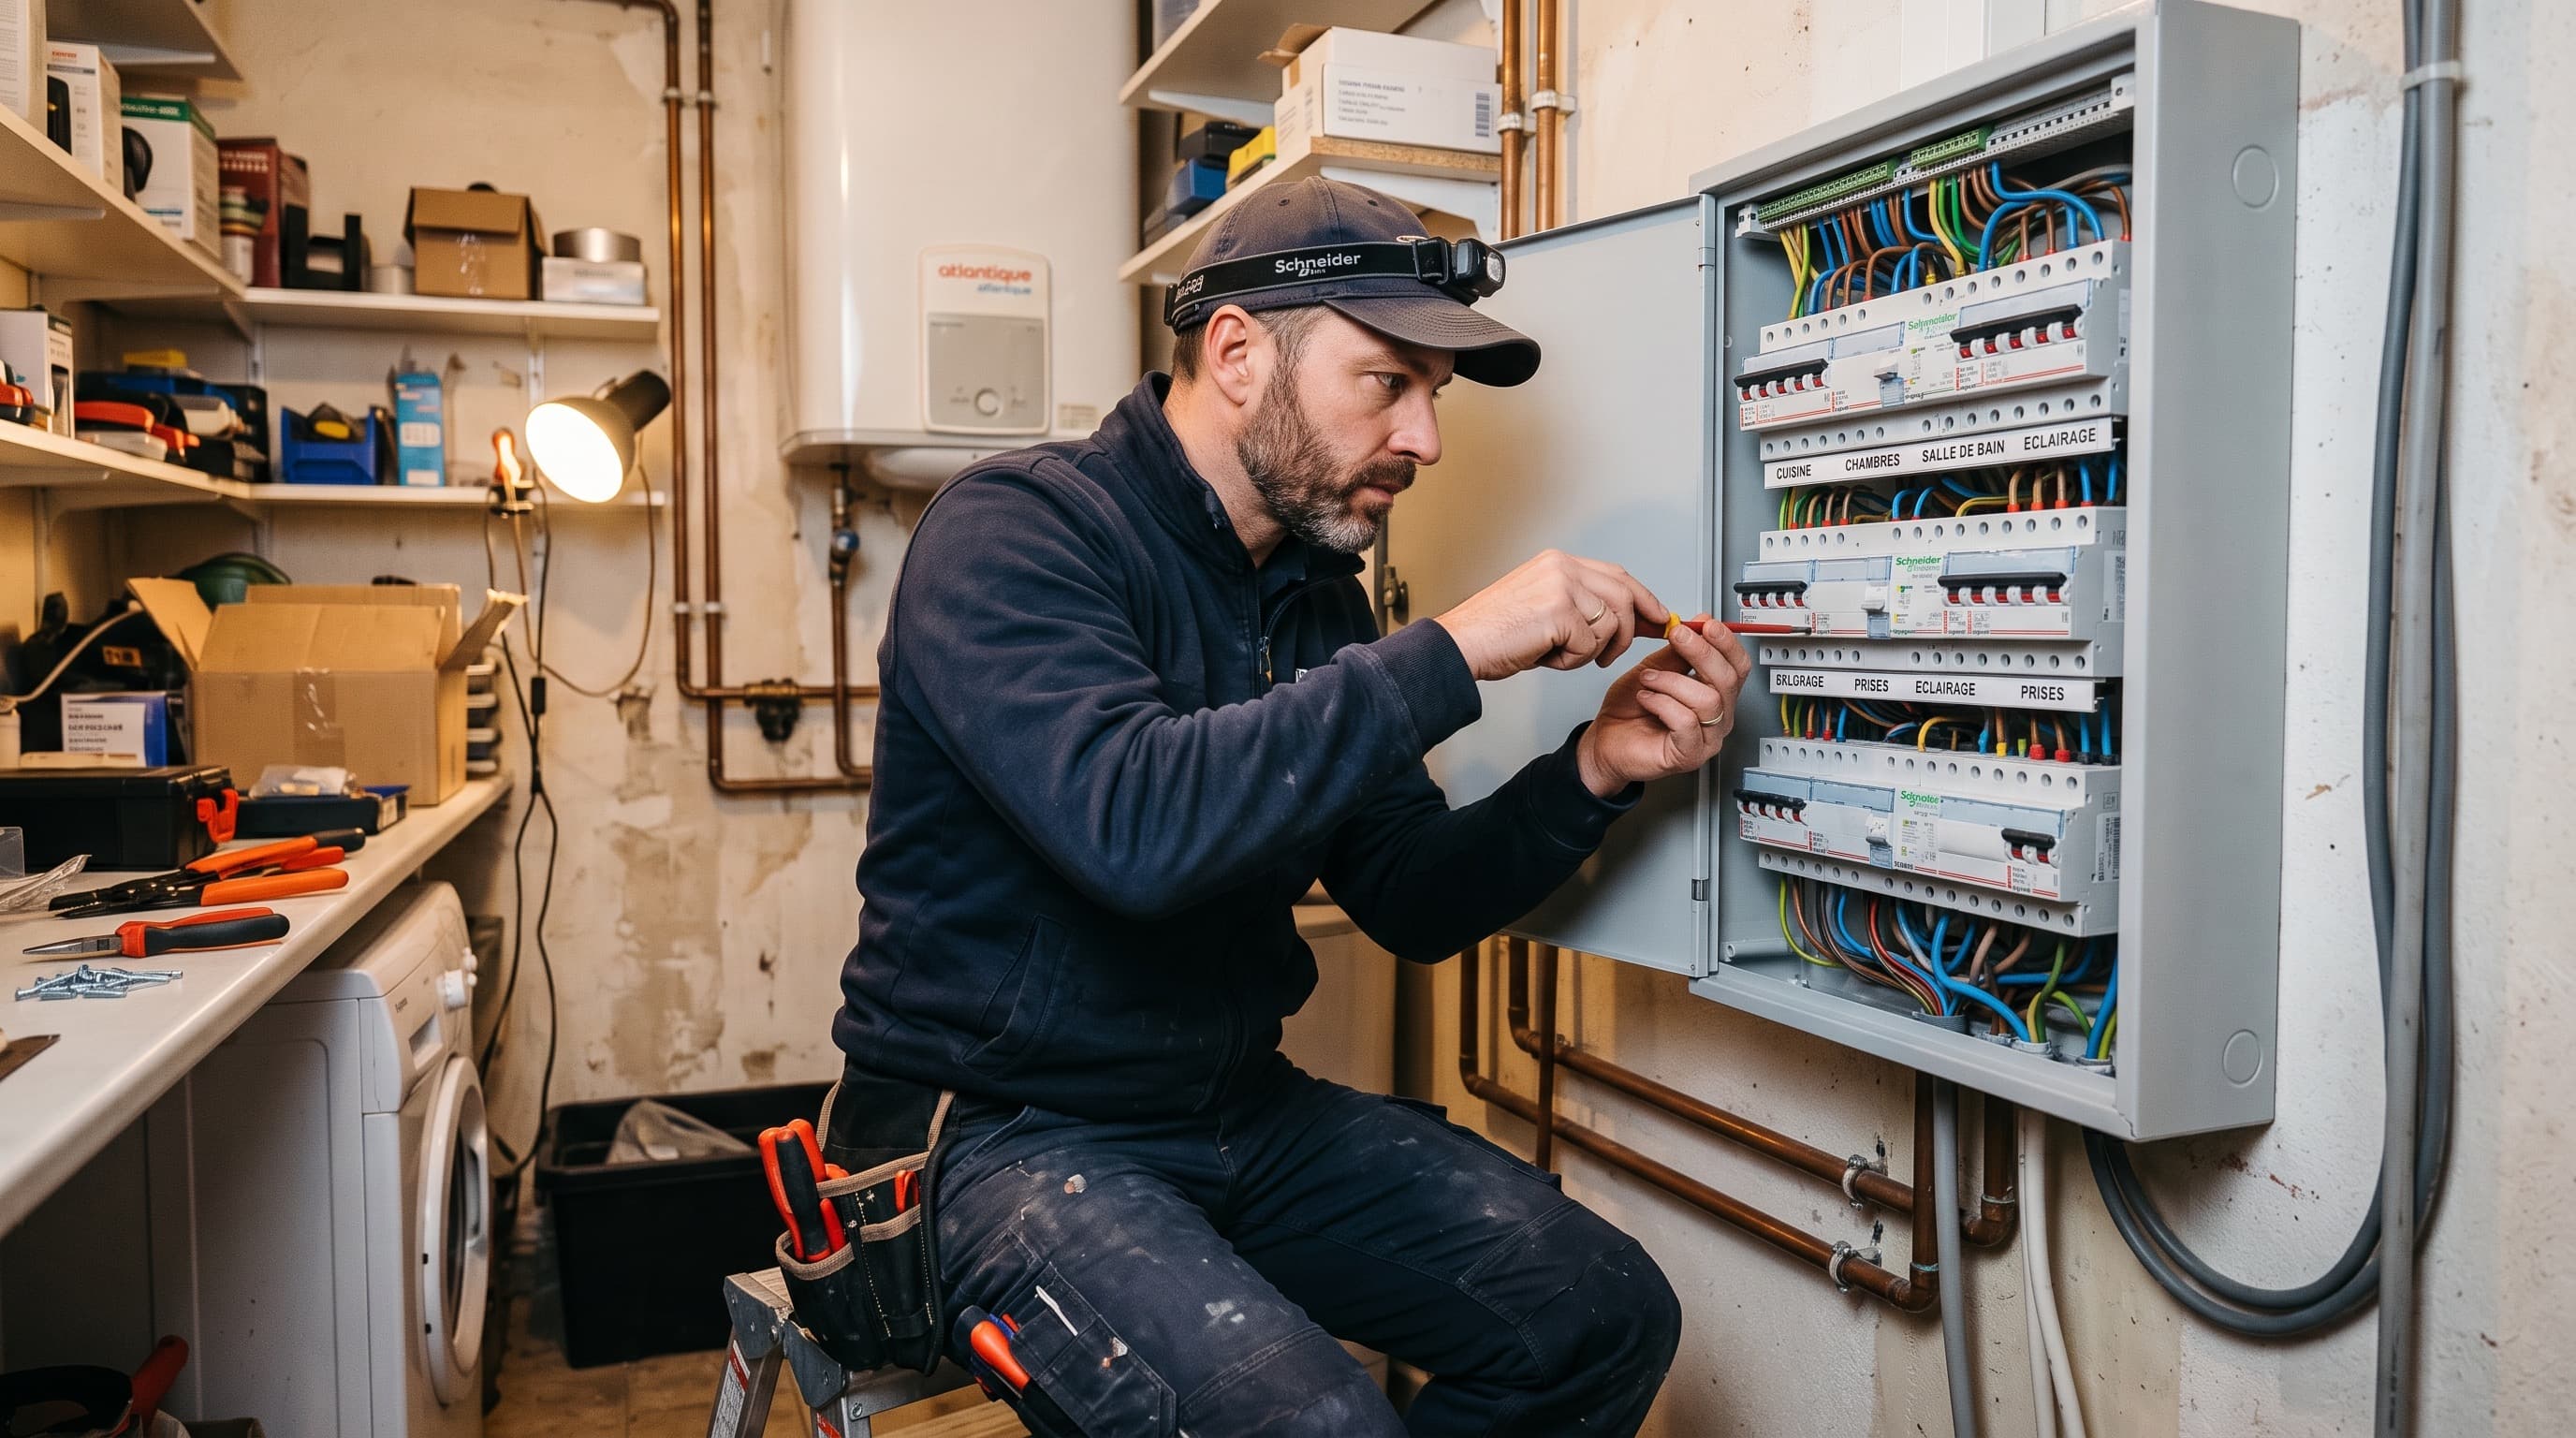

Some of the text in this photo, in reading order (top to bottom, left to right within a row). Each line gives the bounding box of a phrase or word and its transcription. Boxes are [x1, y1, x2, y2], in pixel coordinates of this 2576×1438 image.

[938, 263, 1032, 284] atlantique
[1275, 254, 1361, 273] Schneider
[1777, 427, 2097, 479] CUISINE CHAMBRES SALLE DE BAIN ECLAIRAGE
[1895, 555, 1941, 565] Schneider
[1854, 679, 1889, 692] PRISES
[1915, 681, 1976, 696] ECLAIRAGE
[2021, 685, 2064, 700] PRISES
